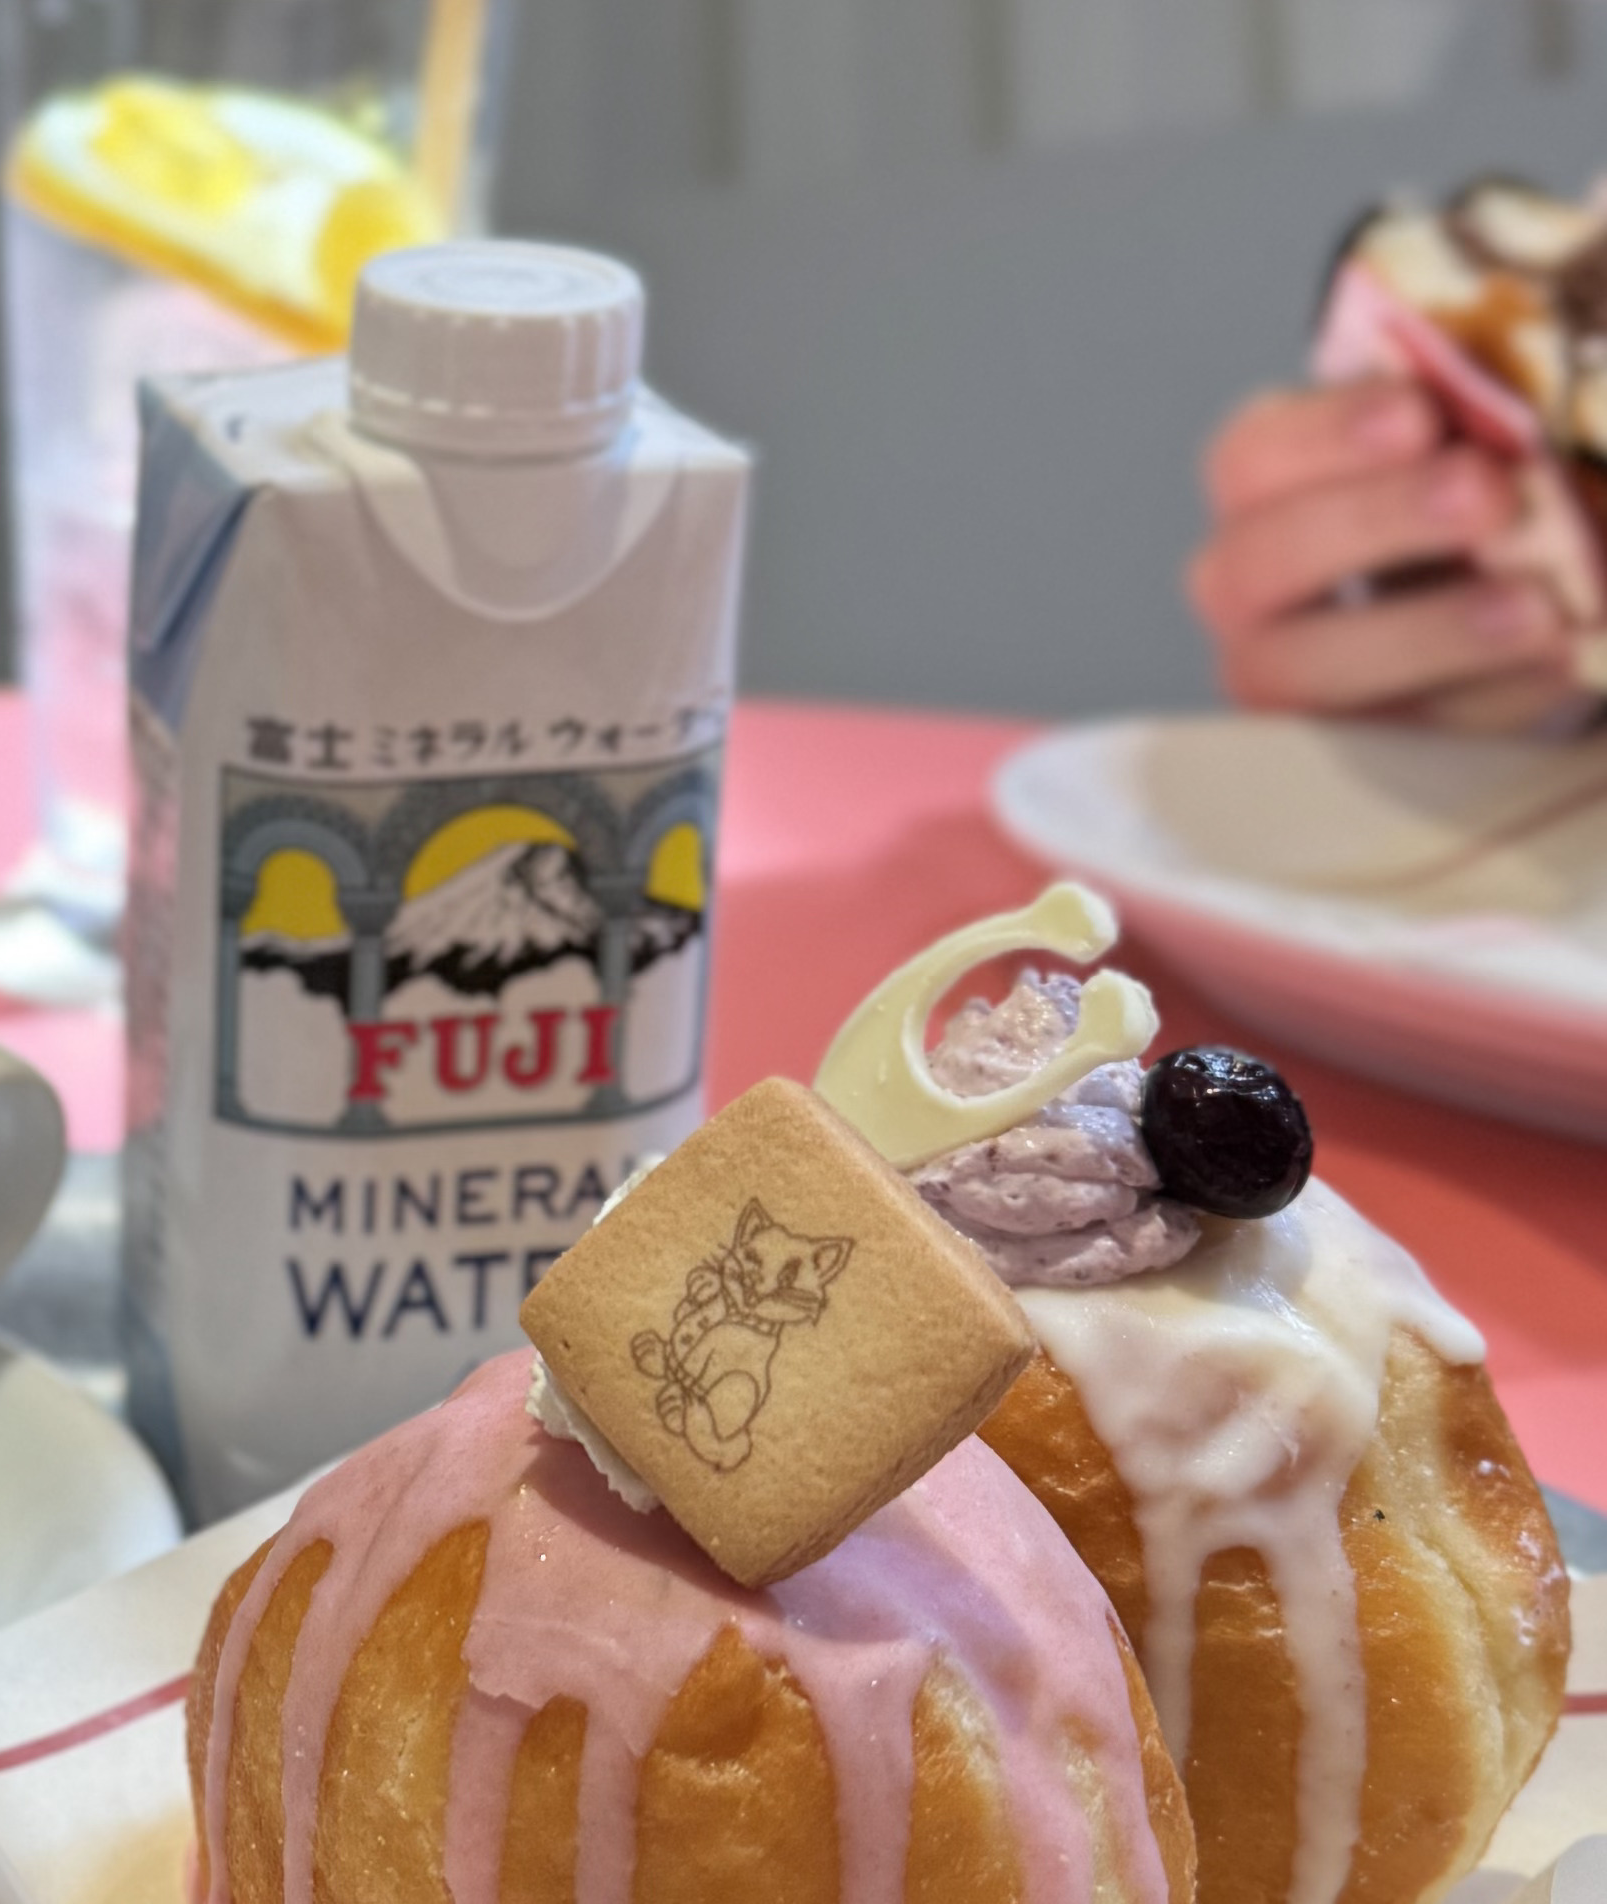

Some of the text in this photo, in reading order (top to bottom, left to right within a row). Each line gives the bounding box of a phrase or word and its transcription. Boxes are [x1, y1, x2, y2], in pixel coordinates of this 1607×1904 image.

[348, 1007, 616, 1099] FUJI
[289, 1151, 639, 1234] MINERA
[287, 1244, 567, 1341] WAT
